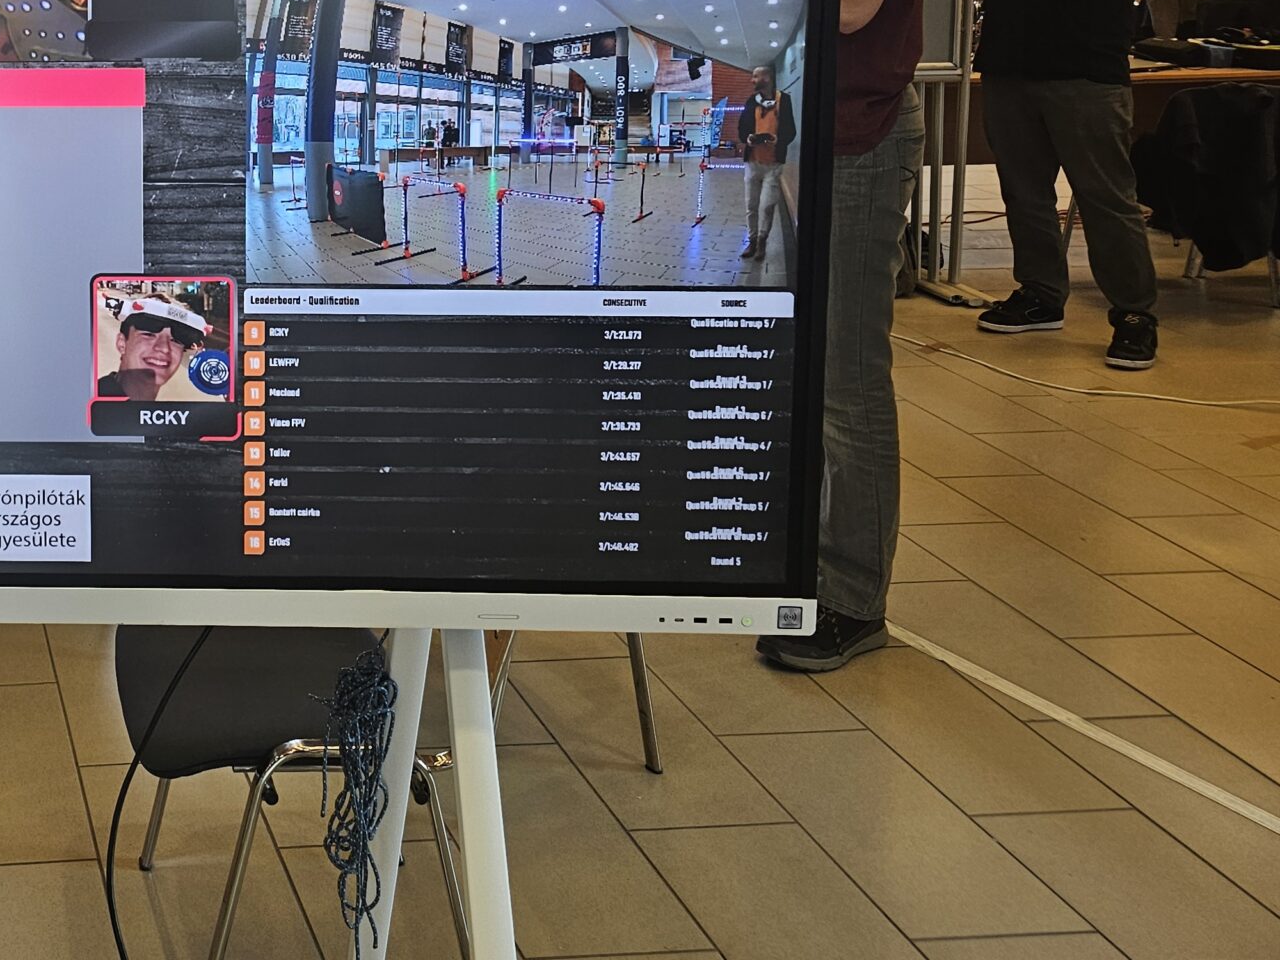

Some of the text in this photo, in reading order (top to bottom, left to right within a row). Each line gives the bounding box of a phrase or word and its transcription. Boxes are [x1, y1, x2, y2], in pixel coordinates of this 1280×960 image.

[250, 296, 301, 306] Leaderboard
[308, 296, 360, 306] Qualification
[603, 298, 647, 307] CONSECUTIVE
[721, 299, 747, 308] SOURCE
[139, 410, 189, 425] RCKY
[291, 417, 306, 427] FPV
